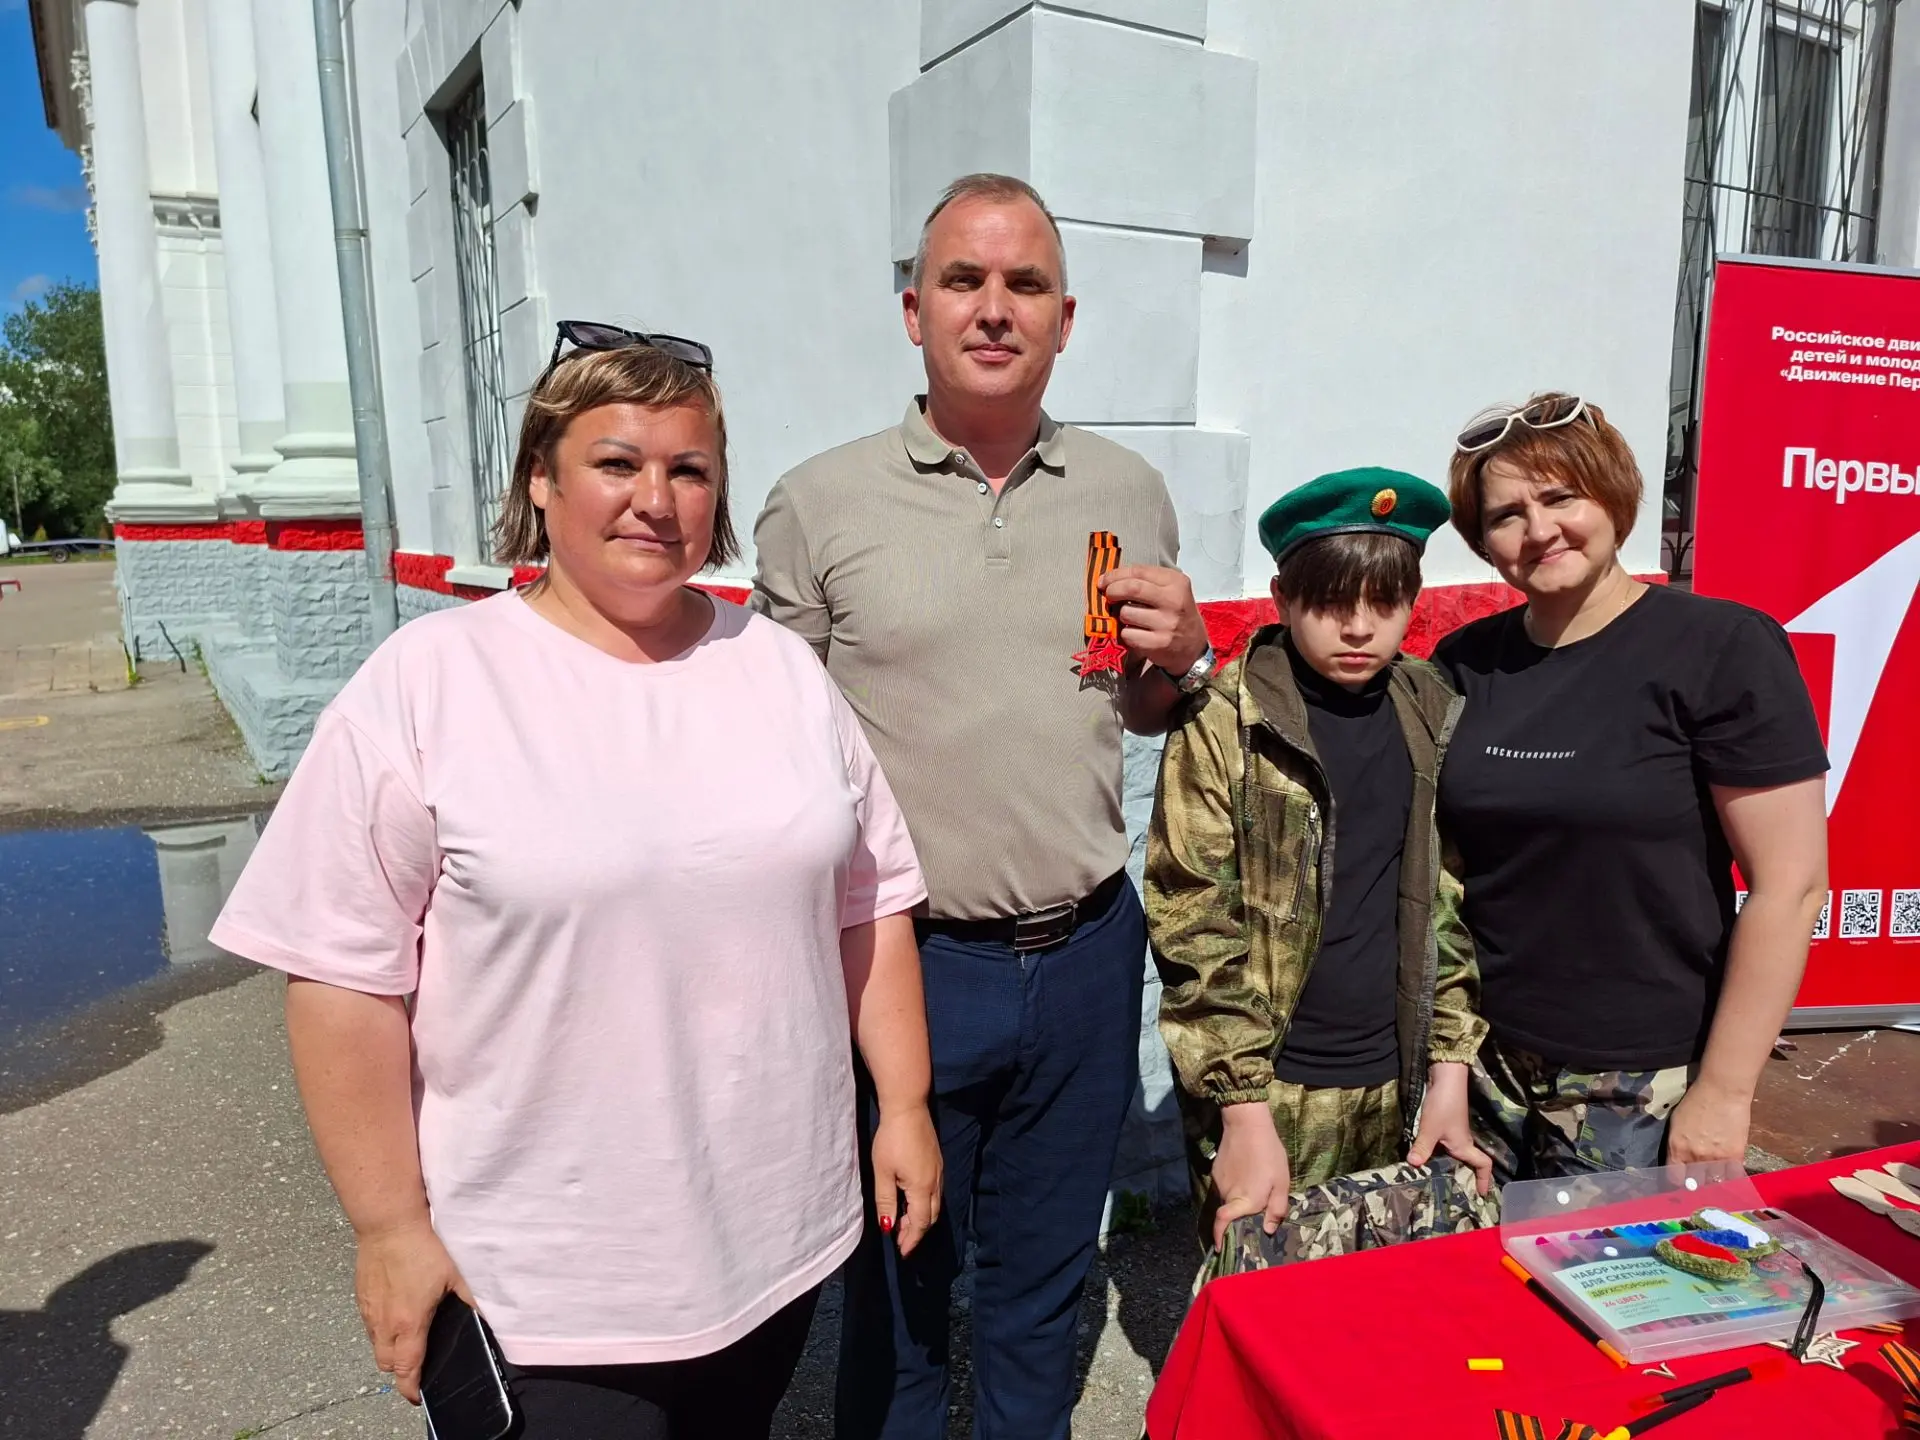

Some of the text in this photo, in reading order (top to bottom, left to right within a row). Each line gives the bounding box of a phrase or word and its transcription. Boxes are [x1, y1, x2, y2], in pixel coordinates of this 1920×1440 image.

[1771, 326, 1885, 348] Российское
[1790, 349, 1920, 372] детей и молод
[1780, 365, 1920, 391] «Движение Пер
[1570, 1266, 1609, 1280] НАБОР
[1580, 1269, 1668, 1289] ДЛЯ СКЕТЧИНГА
[1616, 1293, 1649, 1305] ЦВЕТА
